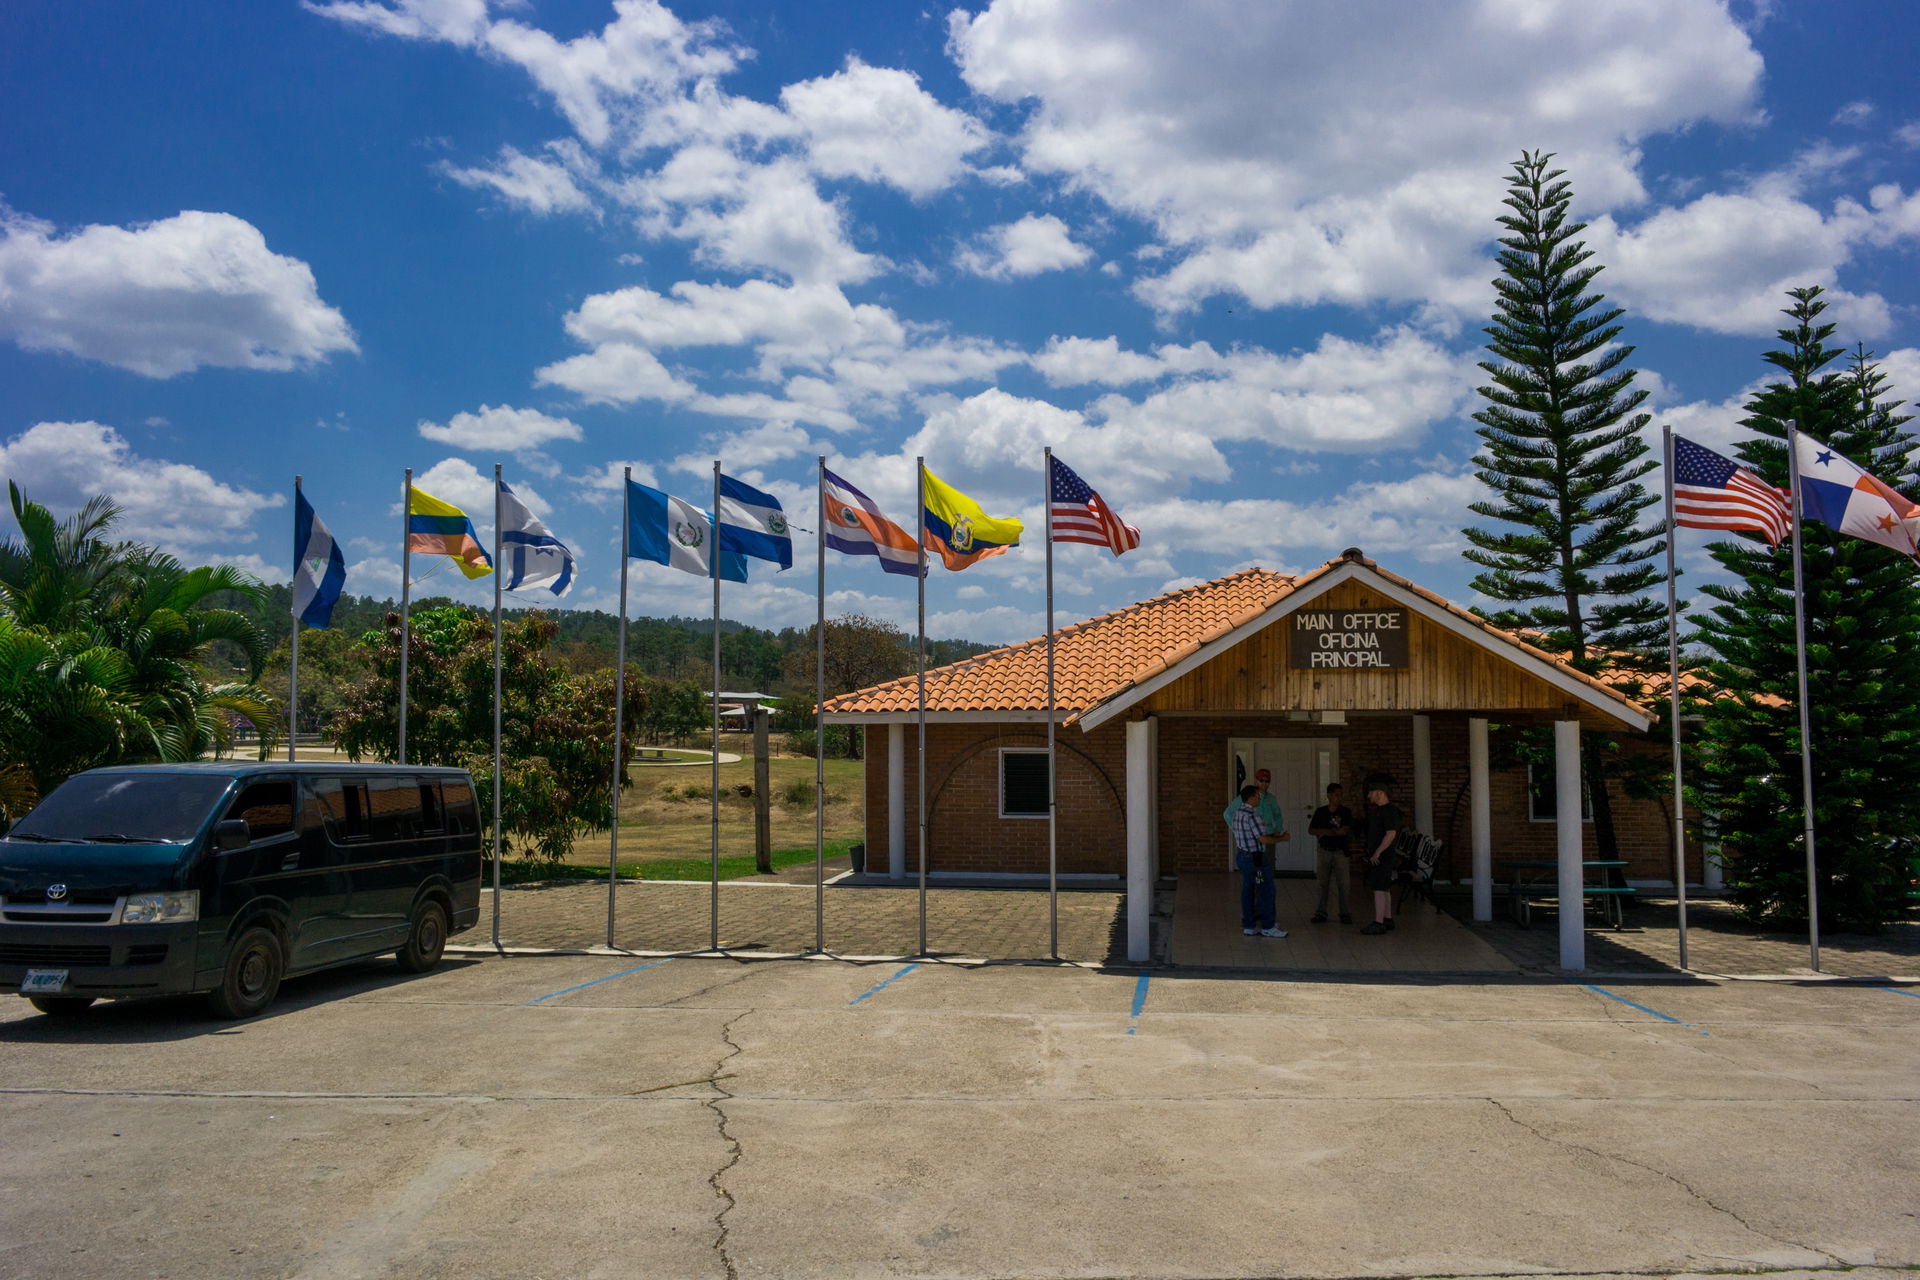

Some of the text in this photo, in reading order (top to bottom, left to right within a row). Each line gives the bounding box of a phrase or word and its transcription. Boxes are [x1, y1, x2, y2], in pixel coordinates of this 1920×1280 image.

[1296, 613, 1400, 630] MAIN OFFICE
[1319, 632, 1379, 649] OFICINA
[1311, 651, 1390, 668] PRINCIPAL
